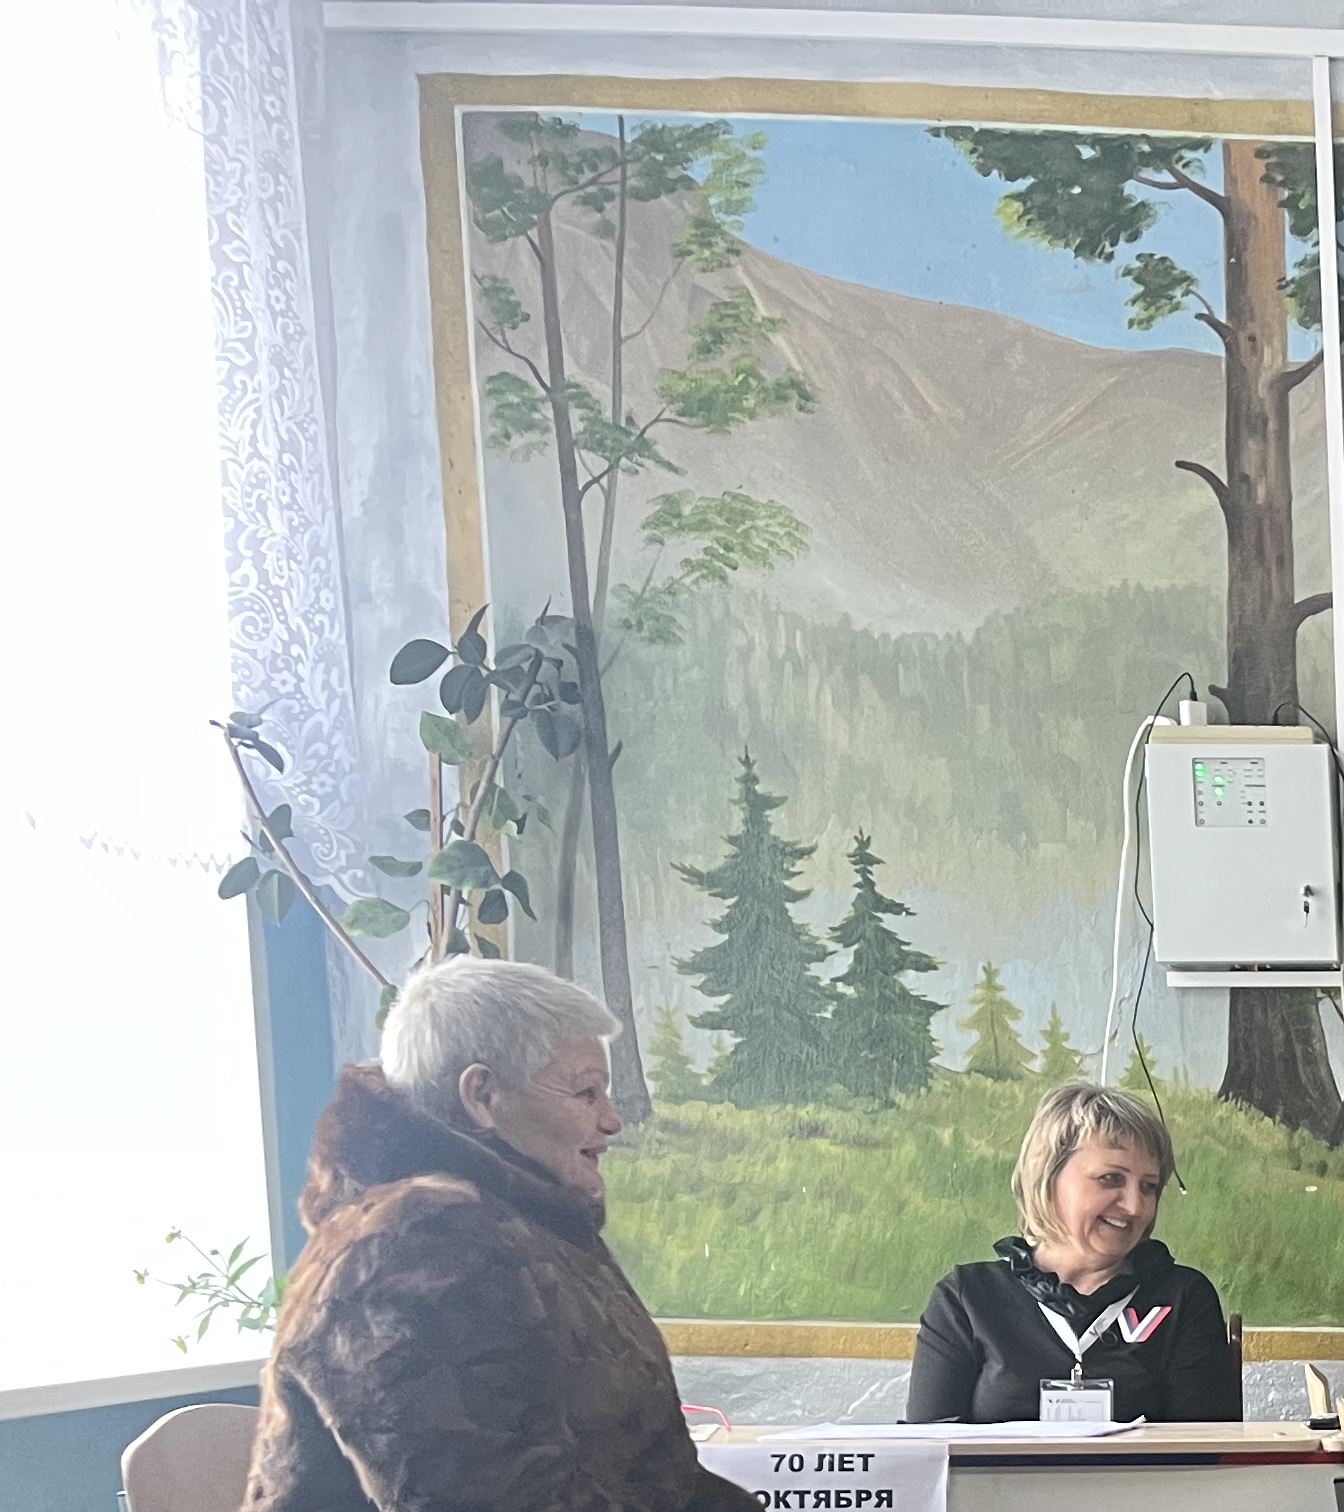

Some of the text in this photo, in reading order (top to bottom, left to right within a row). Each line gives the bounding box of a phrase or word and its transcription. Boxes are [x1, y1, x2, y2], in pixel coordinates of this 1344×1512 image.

[770, 1454, 875, 1472] 70 ЛЕТ
[752, 1490, 893, 1509] ОКТЯБРЯ
